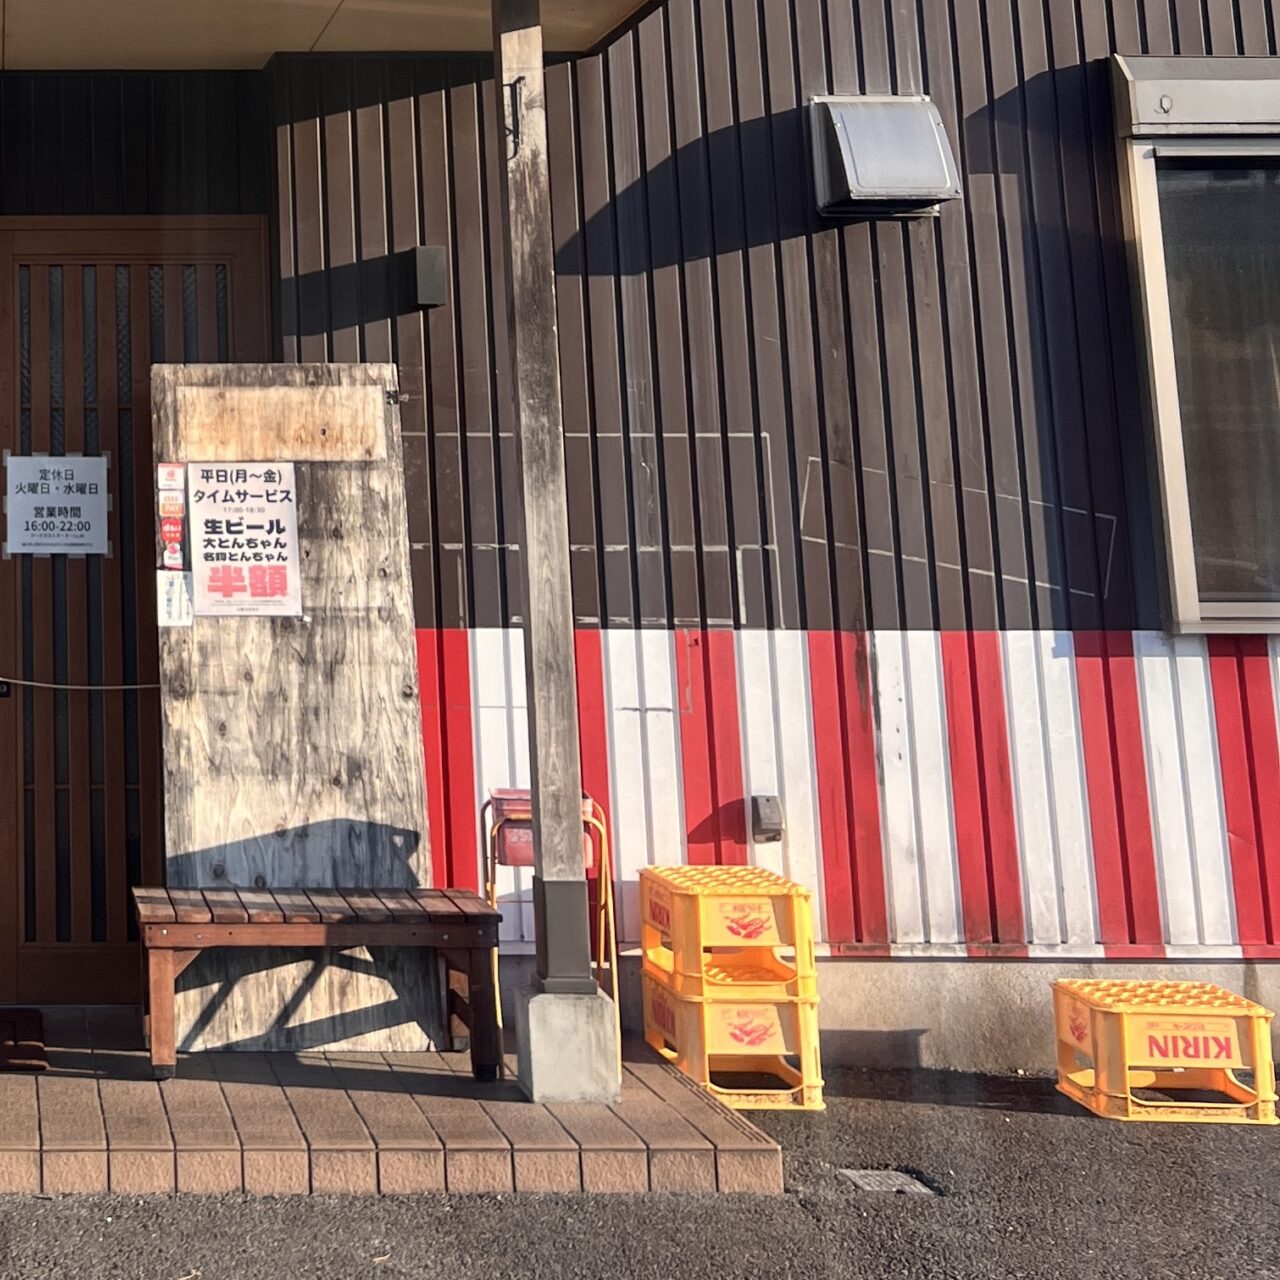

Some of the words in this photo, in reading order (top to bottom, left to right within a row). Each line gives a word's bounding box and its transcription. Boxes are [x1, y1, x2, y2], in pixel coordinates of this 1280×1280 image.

[39, 469, 75, 481] 定休日
[15, 482, 99, 495] 火曜日・水曜日
[193, 489, 293, 503] タイムサービス
[33, 506, 82, 519] 営業時間
[24, 521, 91, 532] 16:00-22:00
[204, 516, 286, 535] 生ビール
[203, 537, 287, 549] 大とんちゃん
[207, 564, 288, 598] 半額
[1148, 1035, 1233, 1060] KIRIN
